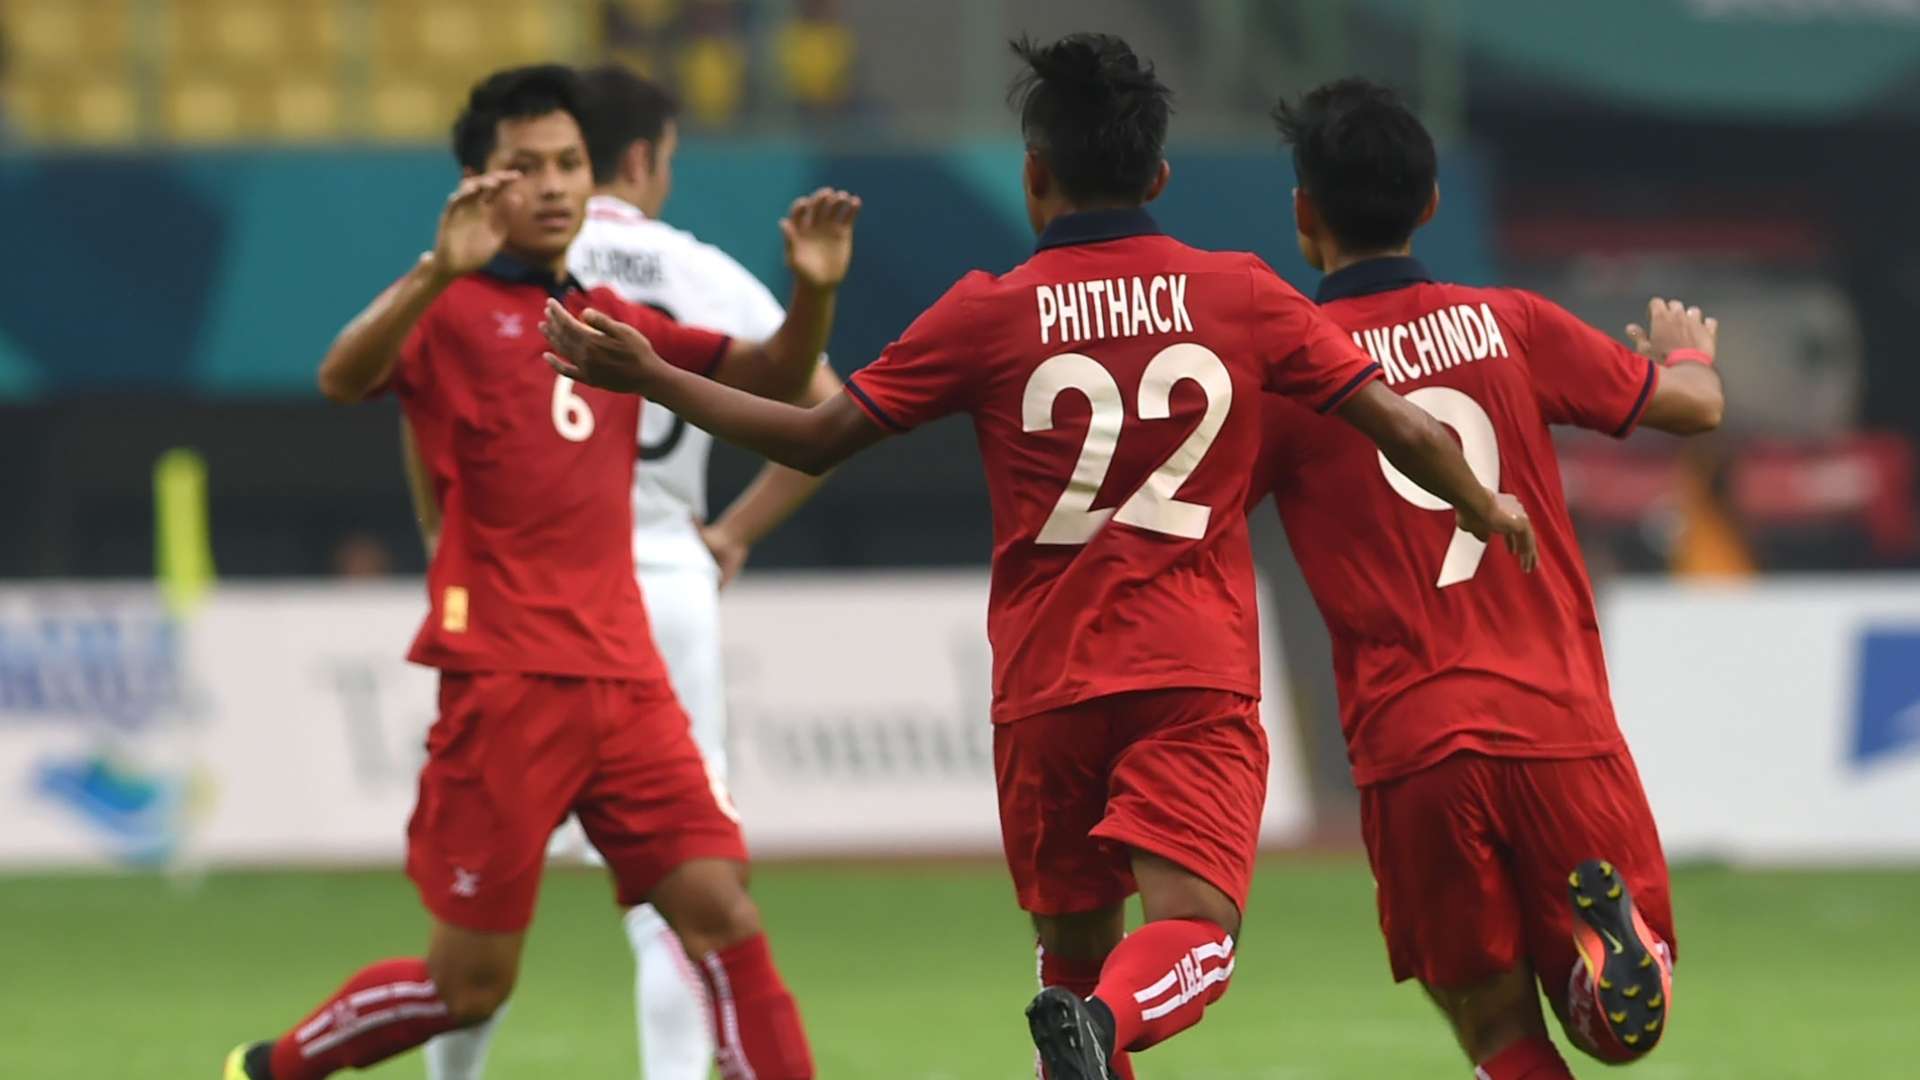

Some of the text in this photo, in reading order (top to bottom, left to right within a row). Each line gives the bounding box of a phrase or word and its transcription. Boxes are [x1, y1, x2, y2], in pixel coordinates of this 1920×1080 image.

[1036, 274, 1193, 344] PHITHACK
[551, 374, 595, 442] 6
[1022, 342, 1233, 546] 22
[1377, 386, 1499, 588] 9
